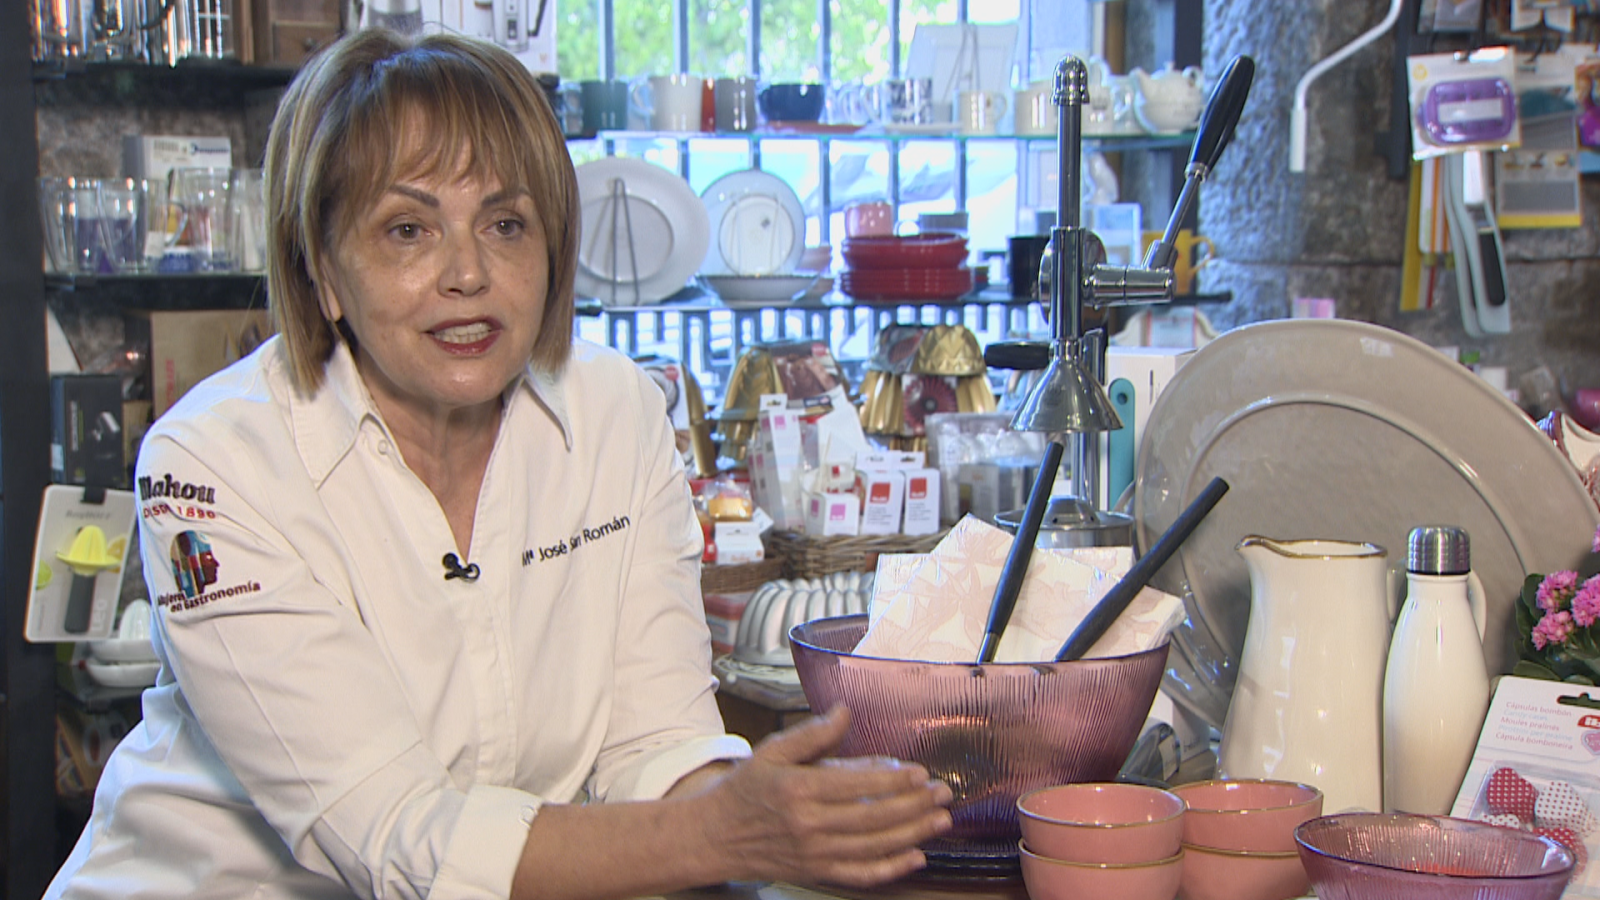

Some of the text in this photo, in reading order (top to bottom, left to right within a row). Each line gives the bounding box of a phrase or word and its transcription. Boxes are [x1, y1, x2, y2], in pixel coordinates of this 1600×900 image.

[138, 473, 215, 504] Mahou
[177, 505, 216, 519] 1890
[539, 539, 567, 562] José
[583, 515, 631, 543] Román
[170, 580, 262, 613] en Gastronomía
[1506, 701, 1572, 717] Cápsulas bombón
[1500, 716, 1528, 726] Moules
[1495, 731, 1573, 750] Cápsula bomboneira
